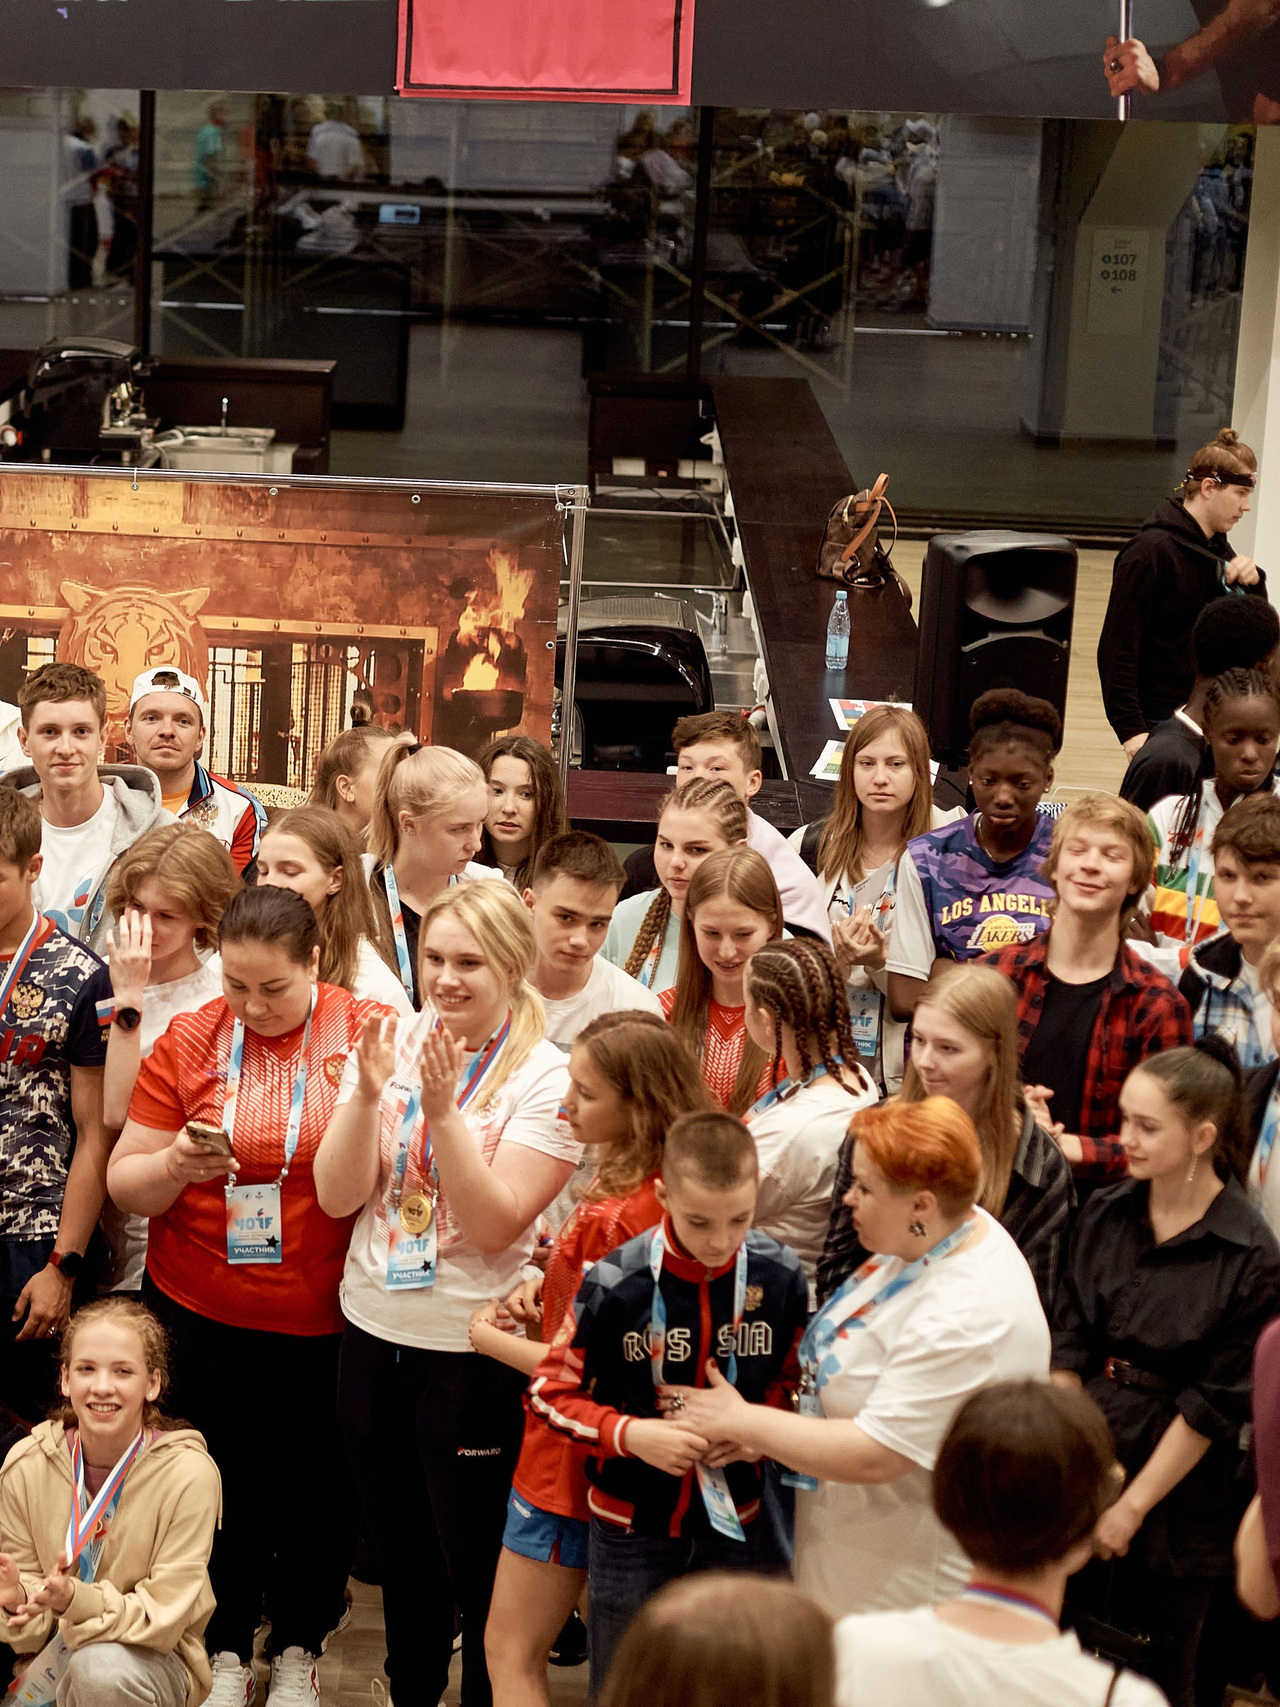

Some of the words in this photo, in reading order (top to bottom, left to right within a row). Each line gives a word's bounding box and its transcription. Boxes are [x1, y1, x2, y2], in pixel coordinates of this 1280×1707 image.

[941, 897, 973, 925] LOS
[979, 893, 1056, 919] ANGELE
[973, 927, 1033, 946] LAKERS
[233, 1246, 275, 1255] УЧАСТНИК
[457, 1446, 501, 1457] FORWARD
